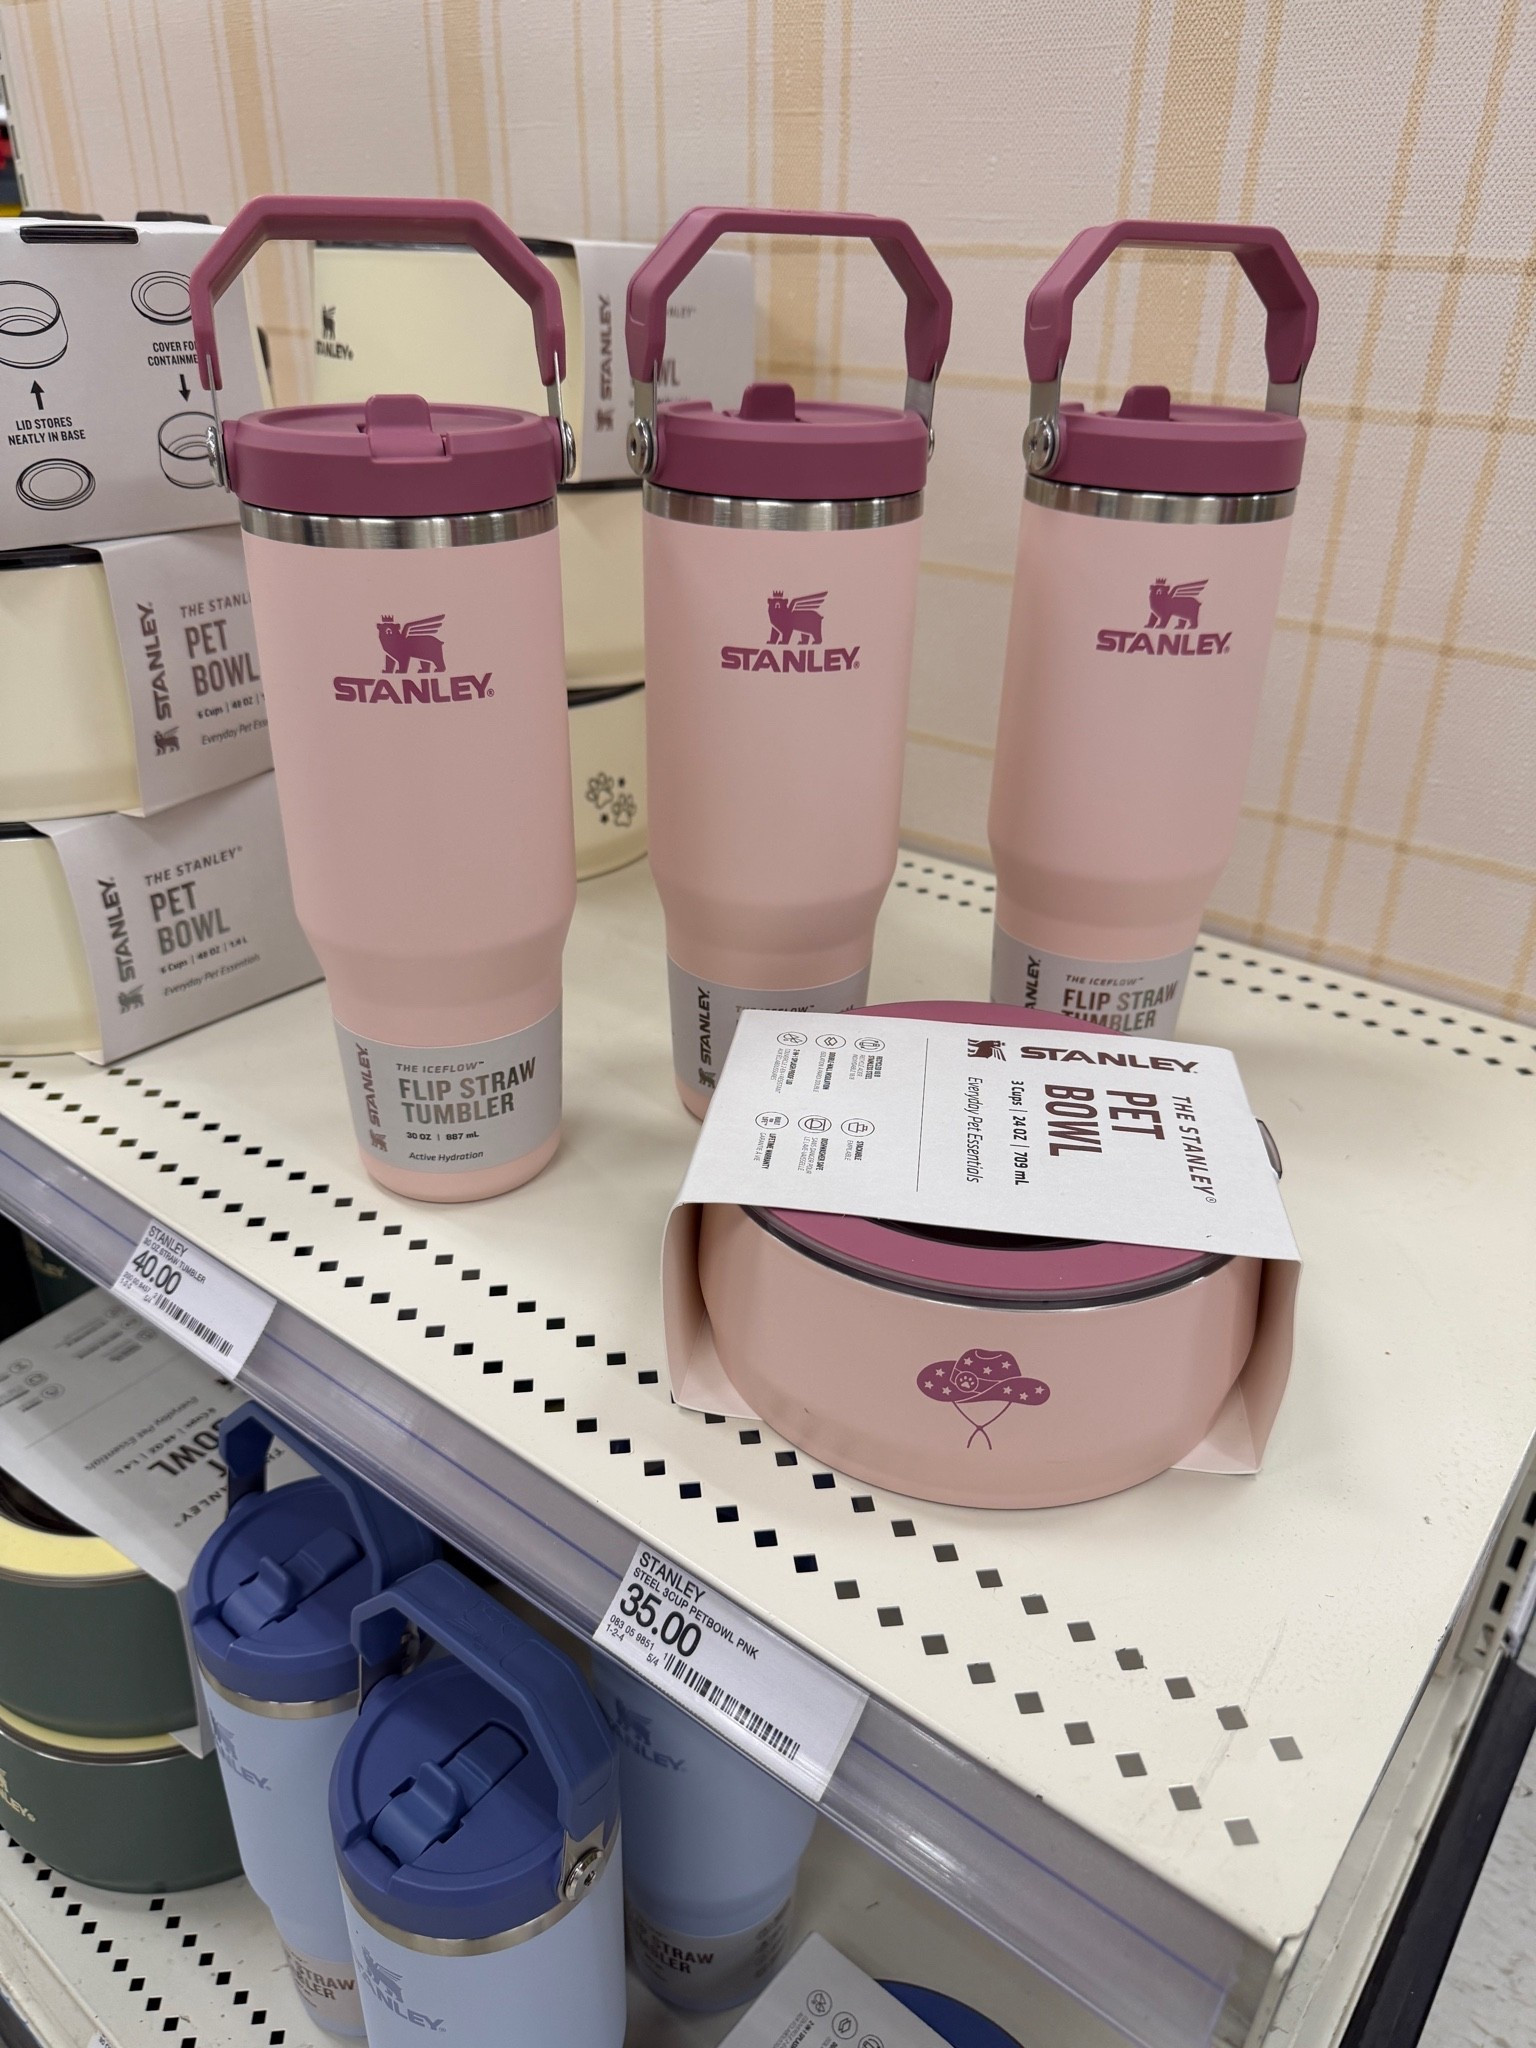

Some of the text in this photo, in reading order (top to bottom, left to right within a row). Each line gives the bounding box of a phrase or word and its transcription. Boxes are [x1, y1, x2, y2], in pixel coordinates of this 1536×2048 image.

[148, 354, 198, 367] CONTAINME
[153, 342, 181, 353] COVER
[8, 429, 86, 446] NEATLY IN BASE
[16, 416, 73, 431] LID STORES
[180, 592, 251, 619] THE STANL
[185, 619, 228, 659] PET
[191, 652, 260, 697] BOWL
[145, 869, 172, 887] THE
[150, 881, 197, 923] PET
[157, 907, 231, 955] BOWL
[167, 960, 188, 974] Cups
[1066, 974, 1086, 984] THE
[1063, 981, 1178, 1012] FLIP STRAW
[396, 1063, 418, 1073] THE
[398, 1056, 536, 1101] FLIP STRAW
[401, 1092, 515, 1125] TUMBLER
[1008, 1087, 1025, 1106] Cups
[1172, 1095, 1195, 1122] THE
[963, 1076, 984, 1183] Everyday Pet Essentials
[1012, 1115, 1026, 1128] 24
[1044, 1083, 1102, 1157] BOWL
[1106, 1089, 1165, 1140] PET
[406, 1131, 479, 1141] 30 OZ 887 mL
[1013, 1128, 1027, 1141] OZ
[409, 1151, 484, 1163] Active Hydration
[1014, 1151, 1028, 1169] 709
[1014, 1172, 1029, 1186] mL
[148, 1225, 189, 1258] STANLEY
[132, 1250, 182, 1295] 40.00
[160, 1248, 181, 1266] STRAW
[180, 1261, 206, 1284] TUMBLER
[639, 1551, 706, 1603] STANLEY
[619, 1583, 702, 1657] 35.00
[633, 1567, 760, 1660] STEEL 3CUP PETBOWL PNK
[605, 1624, 660, 1667] 1-2-4 5/4
[609, 1614, 655, 1651] 083 05 9851
